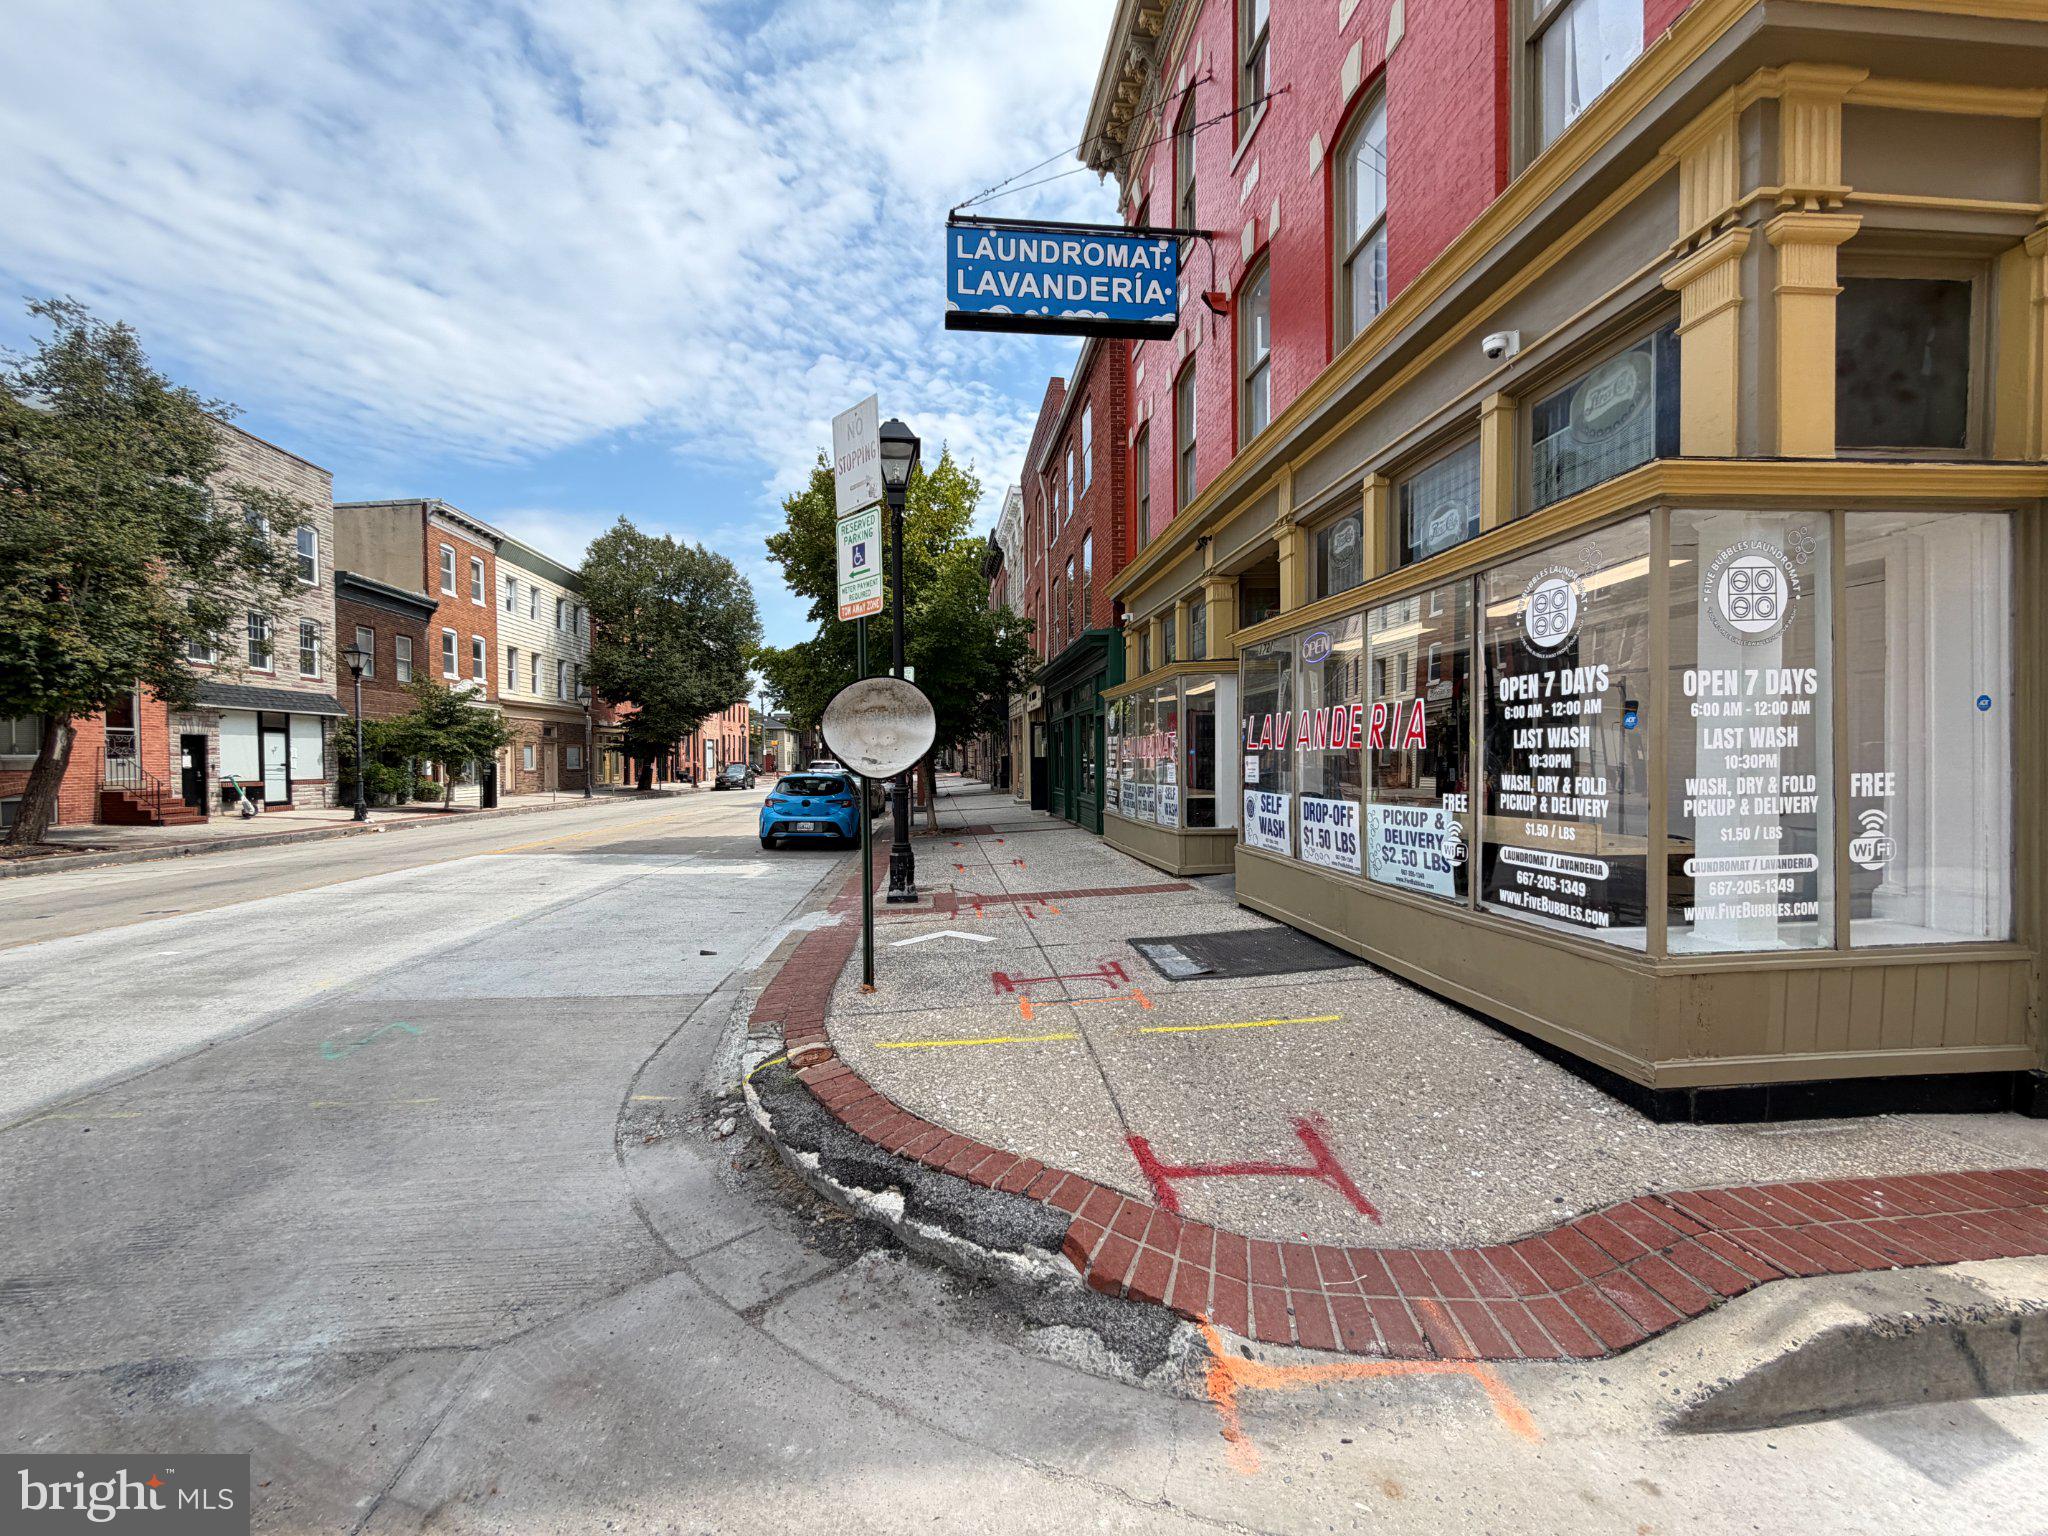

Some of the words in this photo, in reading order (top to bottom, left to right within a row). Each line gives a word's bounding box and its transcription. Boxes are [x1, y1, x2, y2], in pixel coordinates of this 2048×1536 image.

[958, 236, 1166, 270] LAUNDROMAT
[958, 269, 1166, 304] LAVANDERÍA
[848, 418, 863, 440] NO
[838, 441, 876, 475] STOPPING
[841, 515, 875, 535] RESERVED
[844, 528, 873, 546] PARKING
[1704, 571, 1714, 594] FIVE
[1712, 541, 1748, 571] BUBBLES
[1751, 541, 1800, 592] LAUNDROMAT
[842, 584, 855, 594] METER
[857, 578, 878, 589] PAYMENT
[849, 590, 871, 601] REQUIRED
[842, 607, 851, 617] TOW
[867, 599, 880, 610] ZONE
[1303, 636, 1331, 658] OPEN
[1500, 672, 1538, 702] OPEN
[1544, 671, 1555, 697] 7
[1561, 665, 1609, 696] DAYS
[1683, 670, 1737, 697] OPEN
[1745, 670, 1758, 696] 7
[1766, 669, 1818, 695] DAYS
[1505, 705, 1525, 720] 6:00
[1528, 704, 1543, 718] AM
[1552, 700, 1580, 716] 12:00
[1583, 699, 1602, 714] AM
[1691, 702, 1719, 717] 6:00
[1722, 702, 1742, 716] AM
[1754, 701, 1786, 716] 12:00
[1789, 700, 1810, 715] AM
[1513, 729, 1543, 749] LAST
[1547, 726, 1590, 748] WASH
[1704, 728, 1743, 749] LAST
[1748, 726, 1798, 749] WASH
[1528, 754, 1571, 769] 10:30PM
[1724, 754, 1777, 770] 10:30PM
[1502, 774, 1535, 794] WASH,
[1538, 776, 1559, 794] DRY
[1563, 776, 1572, 793] &
[1576, 776, 1607, 796] FOLD
[1685, 778, 1731, 797] WASH,
[1736, 777, 1764, 795] DRY
[1767, 777, 1778, 794] &
[1782, 775, 1816, 792] FOLD
[1851, 773, 1895, 797] FREE
[1261, 794, 1282, 815] SELF
[1442, 793, 1467, 812] FREE
[1500, 794, 1537, 812] PICKUP
[1540, 795, 1549, 813] &
[1552, 796, 1609, 818] DELIVERY
[1683, 799, 1736, 817] PICKUP
[1740, 798, 1751, 815] &
[1754, 796, 1818, 815] DELIVERY
[1304, 801, 1354, 827] DROP-OFF
[1383, 809, 1428, 828] PICKUP
[1435, 813, 1445, 830] &
[1259, 816, 1285, 840] WASH
[1384, 828, 1444, 850] DELIVERY
[1525, 822, 1548, 839] $1.50
[1559, 826, 1576, 841] LBS
[1720, 827, 1750, 842] $1.50
[1763, 826, 1783, 840] LBS
[1304, 825, 1331, 850] $1.50
[1335, 831, 1356, 855] LBS
[1382, 845, 1417, 868] $2.50
[1424, 852, 1451, 874] LBS
[1504, 850, 1546, 868] LAUNDROMAT
[1556, 857, 1603, 876] LAVANDERIA
[1689, 859, 1750, 873] LAUNDROMAT
[1760, 857, 1813, 871] LAVANDERIA
[1517, 871, 1586, 896] 667-205-1349
[1709, 878, 1795, 895] 667-205-1349
